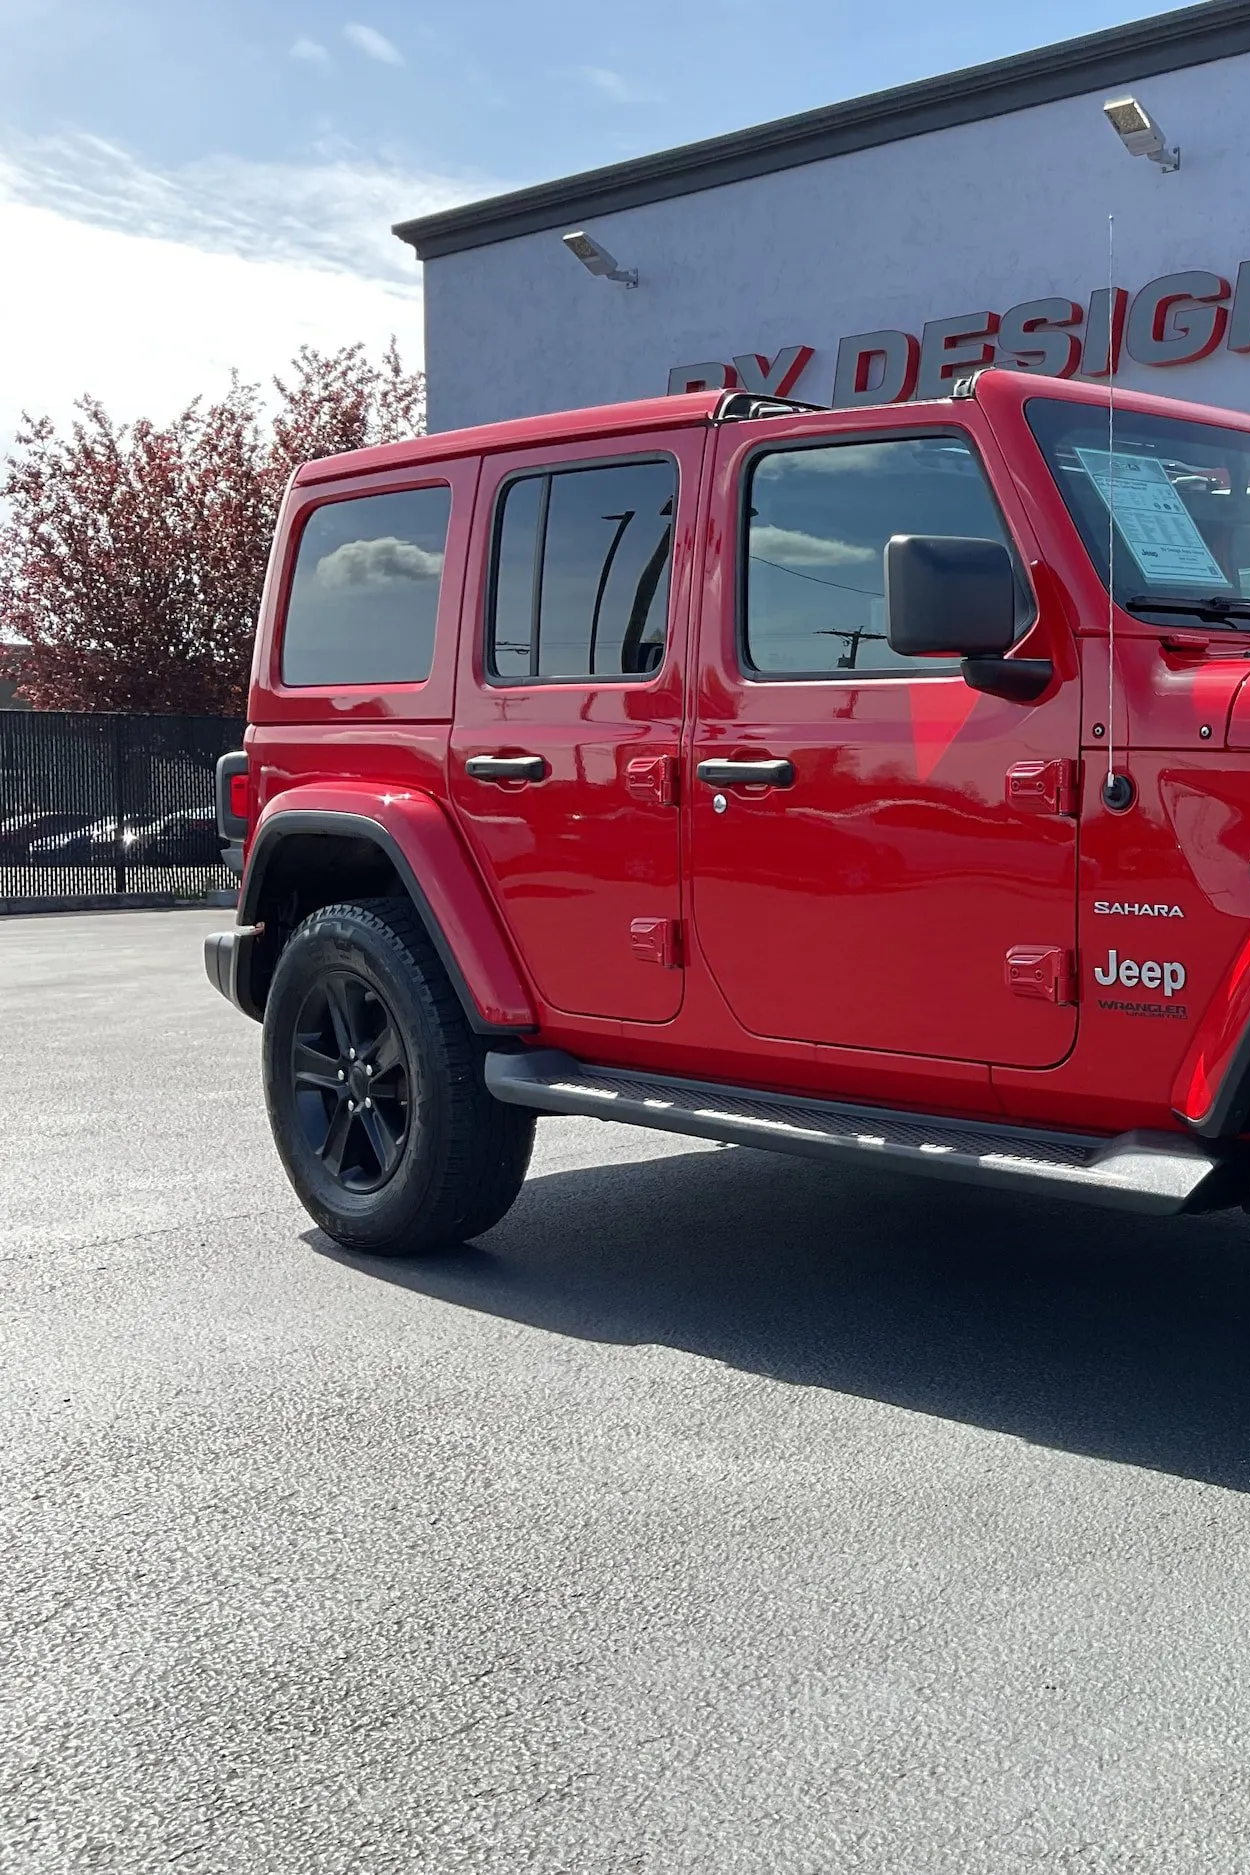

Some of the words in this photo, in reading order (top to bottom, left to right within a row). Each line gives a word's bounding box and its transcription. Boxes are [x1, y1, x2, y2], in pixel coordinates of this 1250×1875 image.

[1094, 902, 1184, 918] SAHARA
[1094, 950, 1186, 996] Jeep
[1097, 1000, 1186, 1014] WRANGLER
